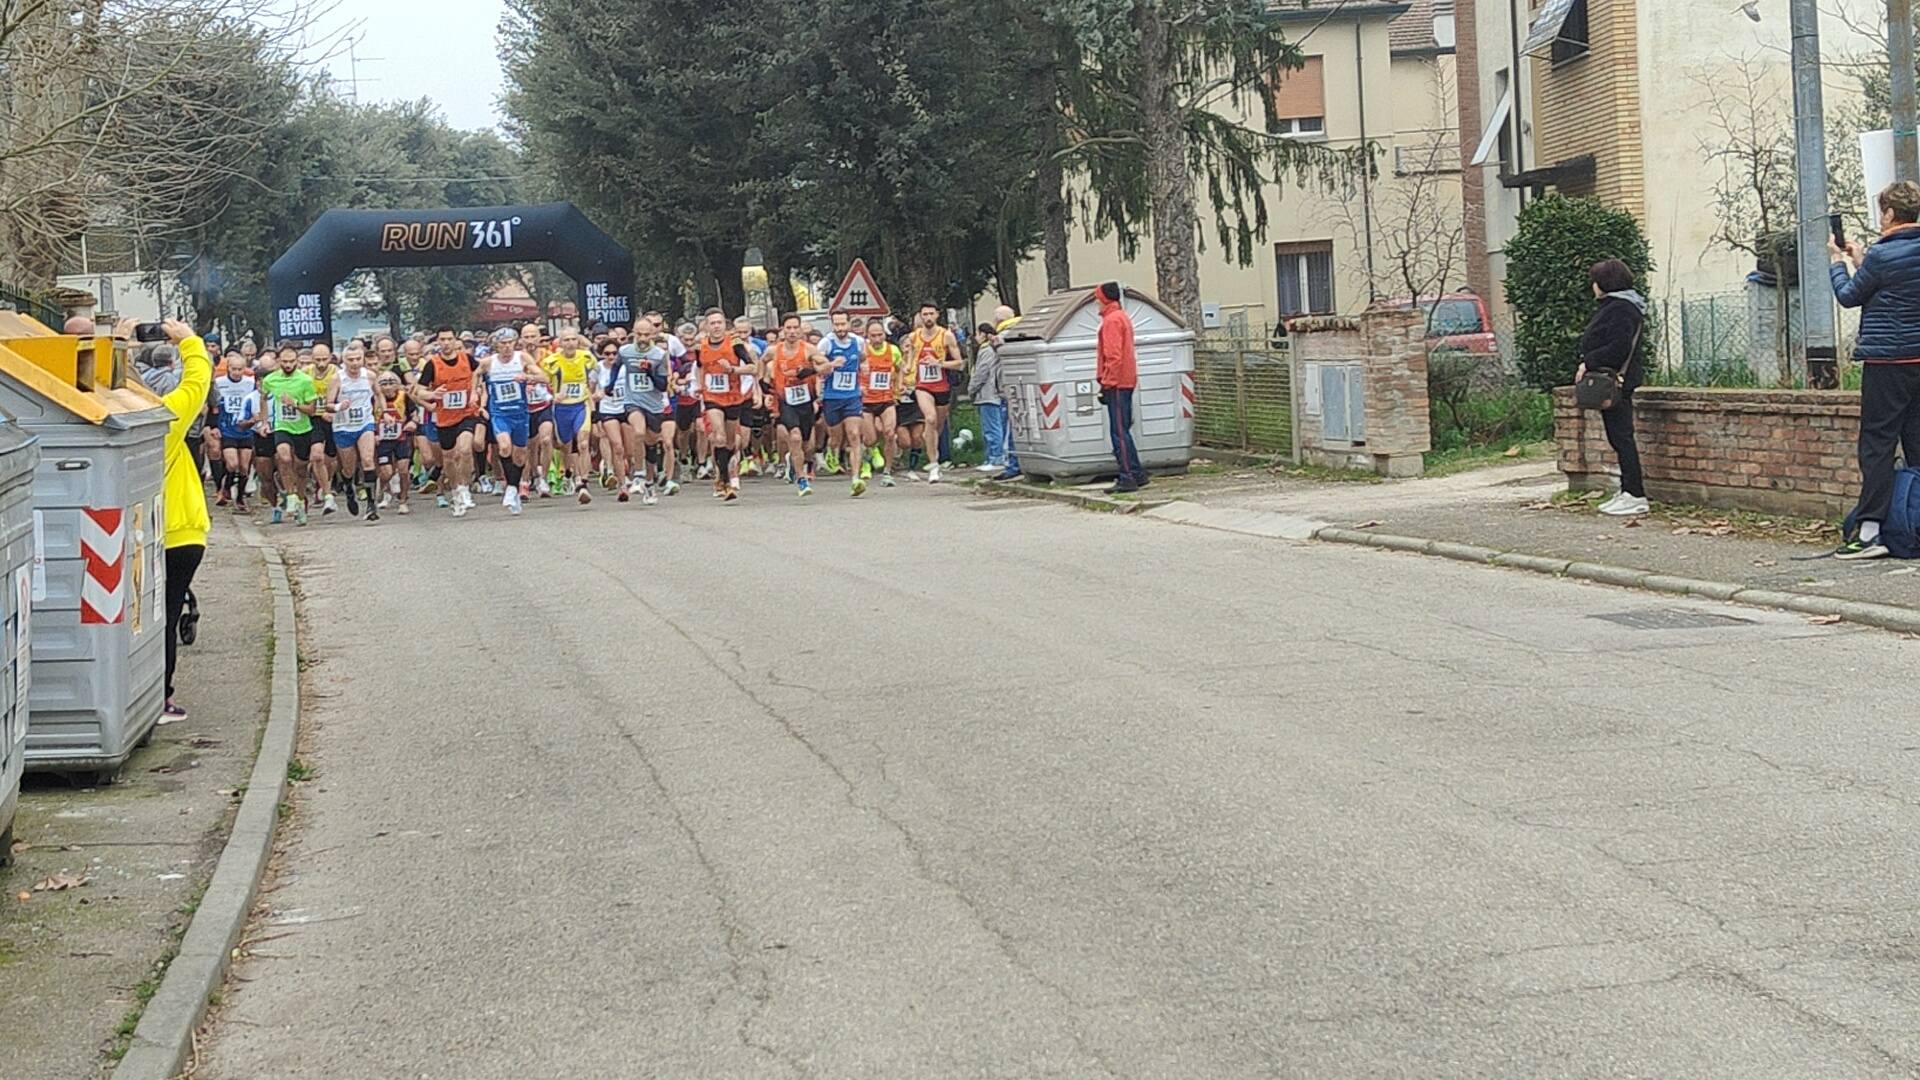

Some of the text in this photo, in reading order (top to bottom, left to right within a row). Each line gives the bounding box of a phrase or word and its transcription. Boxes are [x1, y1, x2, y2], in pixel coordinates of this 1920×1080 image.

[382, 221, 466, 251] RUN
[586, 283, 608, 297] ONE
[298, 294, 321, 307] ONE
[587, 296, 628, 309] DEGREE
[279, 308, 322, 322] DEGREE
[588, 310, 630, 322] BEYOND
[280, 321, 324, 336] BEYOND
